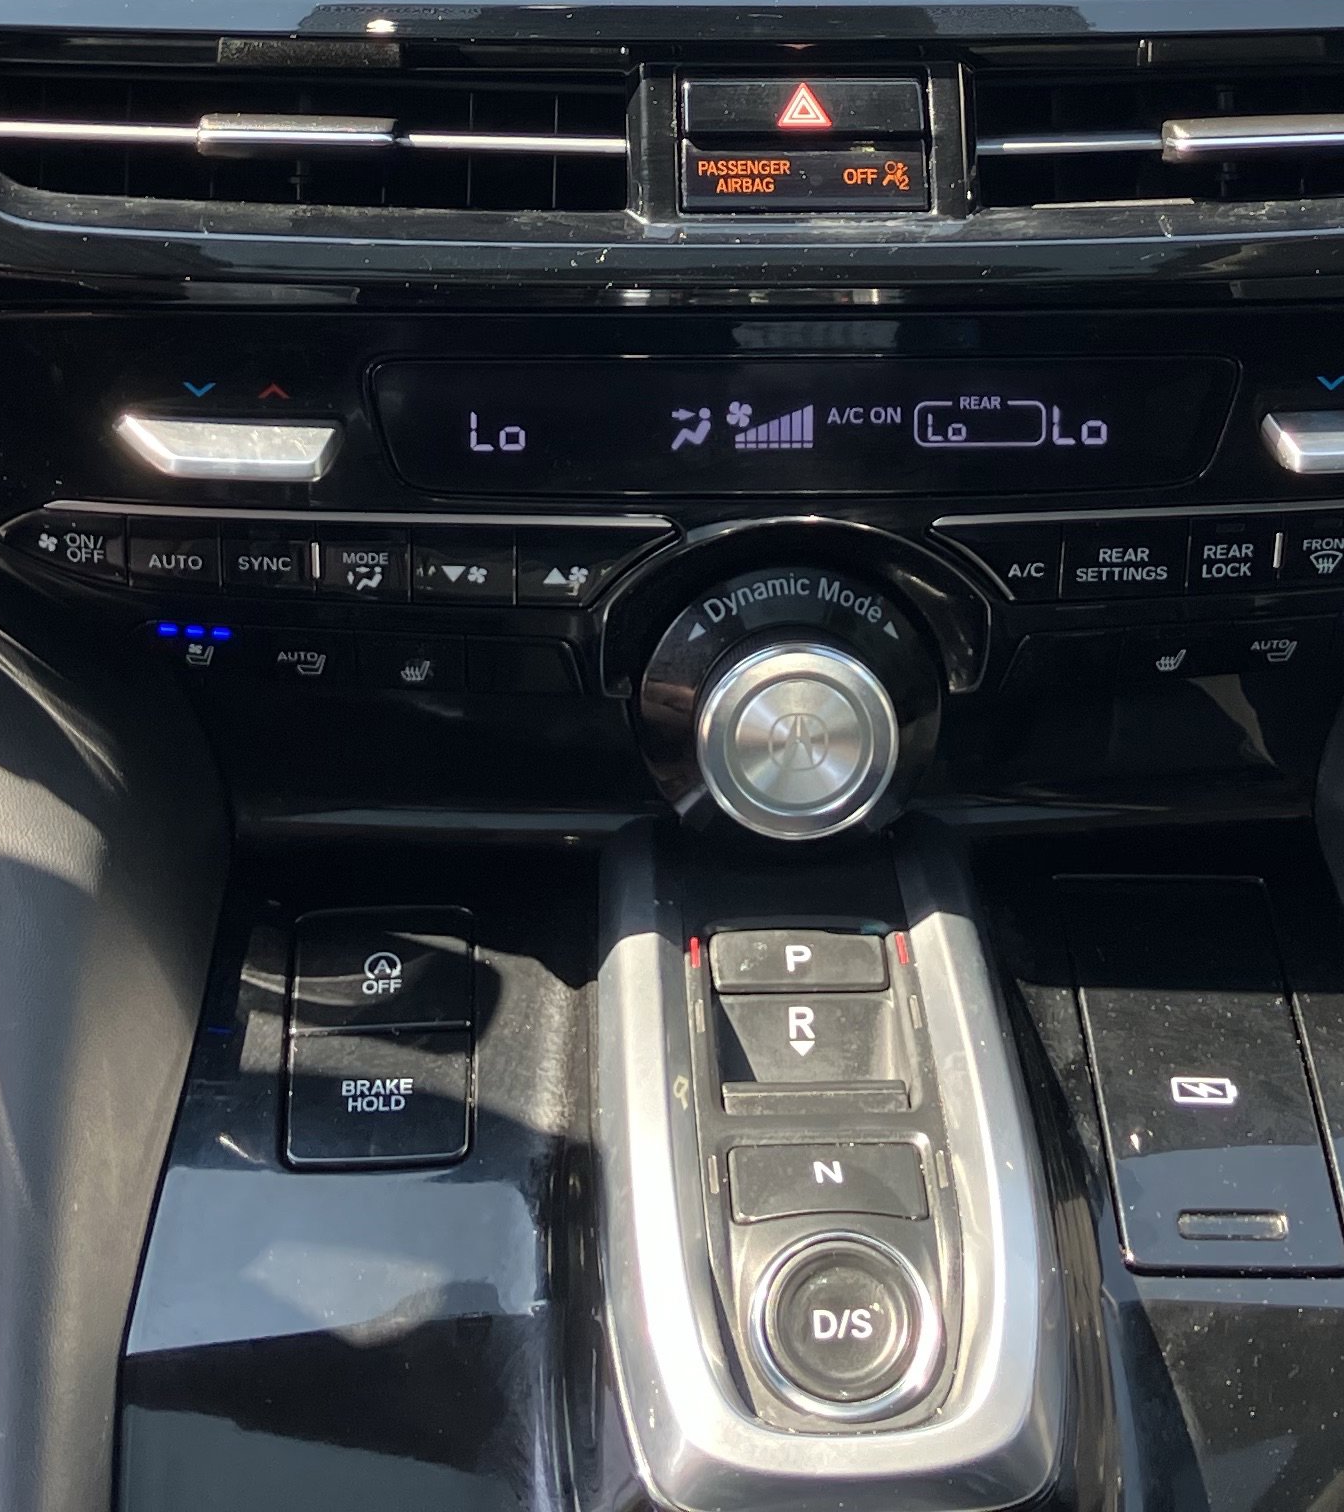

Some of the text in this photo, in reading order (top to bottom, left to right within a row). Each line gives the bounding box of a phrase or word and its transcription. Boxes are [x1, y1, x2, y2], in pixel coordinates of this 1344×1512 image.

[698, 160, 790, 176] PASSENGER
[842, 168, 879, 186] OFF
[716, 178, 775, 193] AIRBAG
[959, 395, 1002, 411] REAR
[826, 406, 903, 425] A/C ON
[65, 532, 105, 552] ON/
[1202, 542, 1255, 561] REAR
[66, 547, 106, 565] OFF
[148, 553, 204, 572] AUTO
[237, 554, 293, 573] SYNC
[342, 551, 390, 567] MODE
[1098, 546, 1150, 564] REAR
[1007, 561, 1046, 580] A/C
[1075, 565, 1169, 583] SETTINGS
[1201, 561, 1253, 580] LOCK
[702, 572, 884, 624] Dynamic Mode
[1251, 639, 1291, 652] AUTO
[277, 650, 318, 662] AUTO
[784, 944, 812, 972] P
[362, 978, 403, 995] OFF
[787, 1005, 815, 1040] R
[341, 1077, 414, 1097] BRAKE
[347, 1095, 406, 1113] HOLD
[813, 1160, 844, 1184] N
[812, 1308, 873, 1340] D/S
